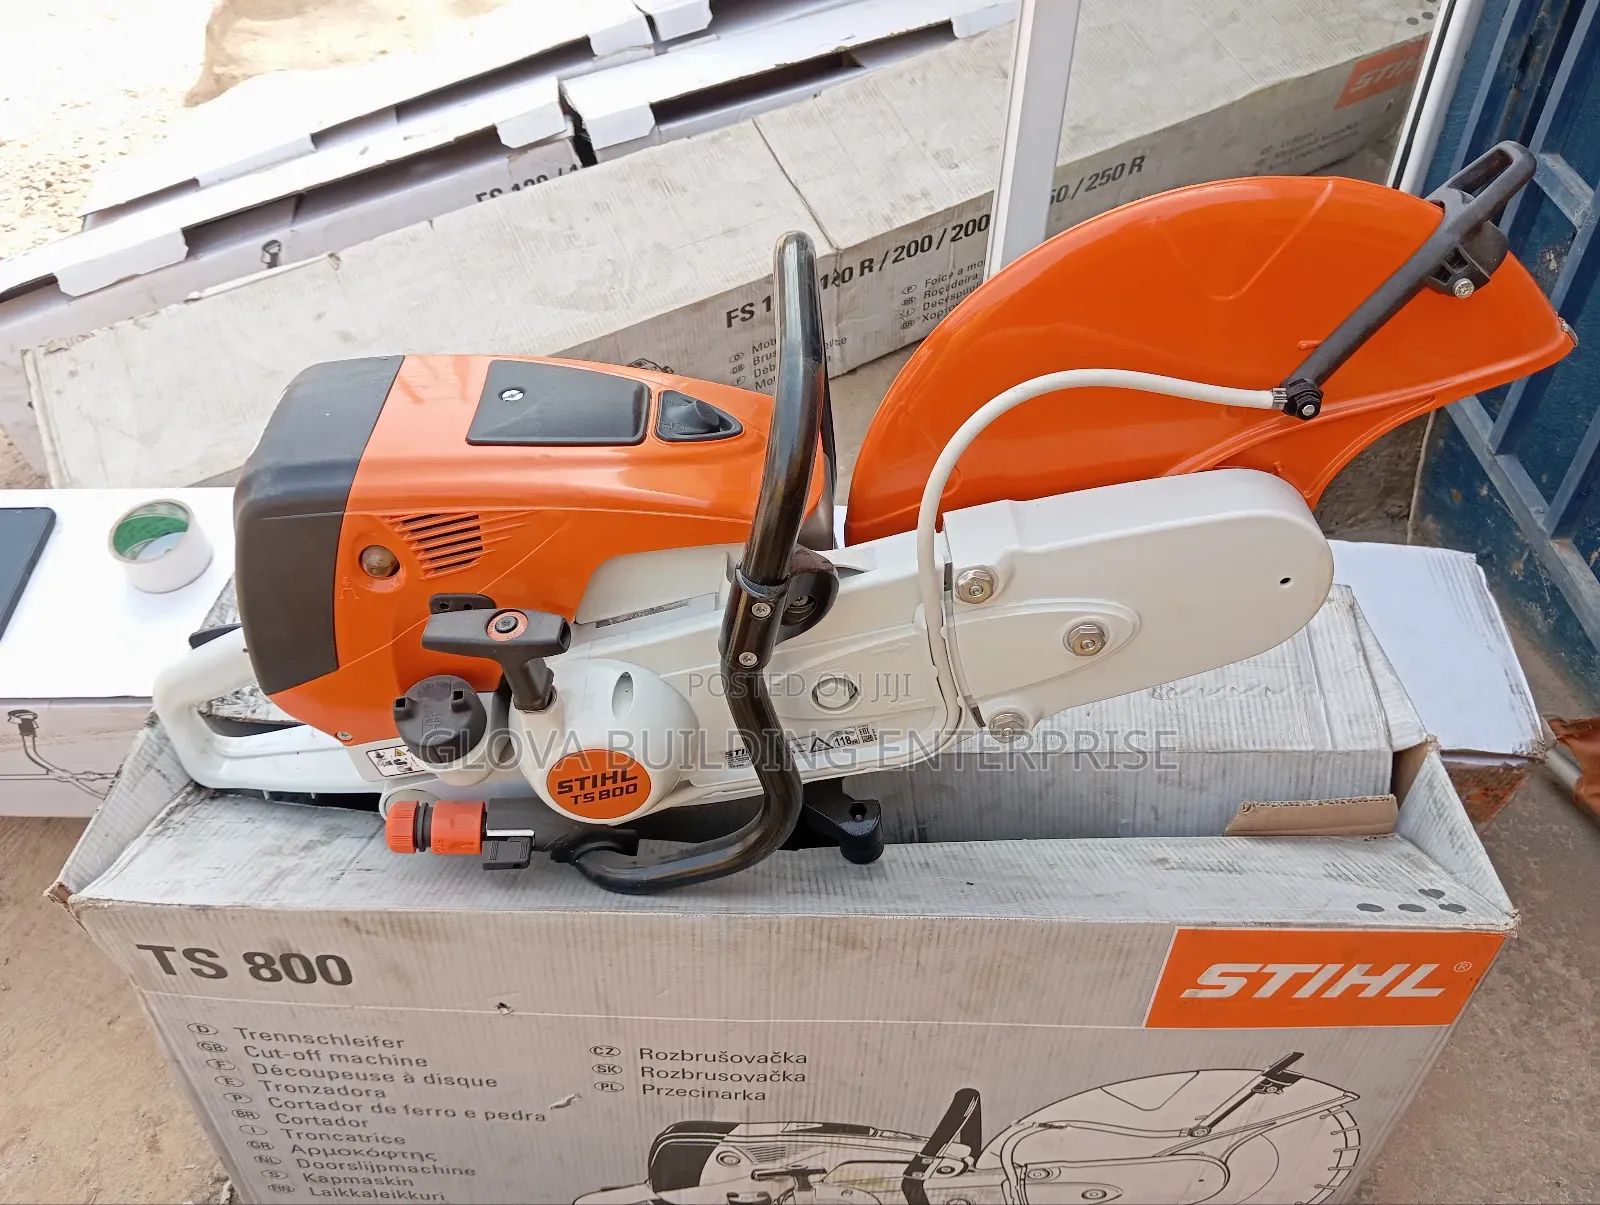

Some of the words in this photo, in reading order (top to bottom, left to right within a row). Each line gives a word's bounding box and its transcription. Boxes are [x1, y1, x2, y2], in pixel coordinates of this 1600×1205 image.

[725, 302, 756, 328] FS
[859, 257, 875, 278] R
[892, 234, 933, 264] 200
[950, 213, 990, 243] 200
[1085, 162, 1125, 193] 250
[1128, 155, 1146, 174] R
[557, 768, 638, 795] STIHL
[570, 793, 595, 806] TS
[598, 783, 638, 801] 800
[135, 943, 228, 980] TS
[243, 951, 353, 986] 800
[1179, 963, 1446, 998] STIHL
[233, 1027, 405, 1049] Trennschleifer
[243, 1045, 322, 1062] Cut-off
[329, 1053, 428, 1067] machine
[639, 1047, 808, 1064] Rozbrušovačka
[252, 1062, 395, 1082] Découpeuse
[423, 1073, 498, 1089] disque
[641, 1066, 807, 1083] Rozbrusovačka
[258, 1080, 386, 1098] Tronzadora
[642, 1083, 767, 1101] Przecinarka
[268, 1096, 363, 1113] Cortador
[370, 1103, 397, 1115] de
[403, 1104, 456, 1118] ferro
[464, 1109, 476, 1119] e
[484, 1110, 546, 1122] pedra
[275, 1113, 369, 1128] Cortador
[280, 1128, 407, 1145] Troncatrice
[296, 1158, 476, 1176] Doorslijpmachine
[302, 1172, 414, 1187] Kapmaskin
[308, 1186, 445, 1201] Laikkaleikkuri
